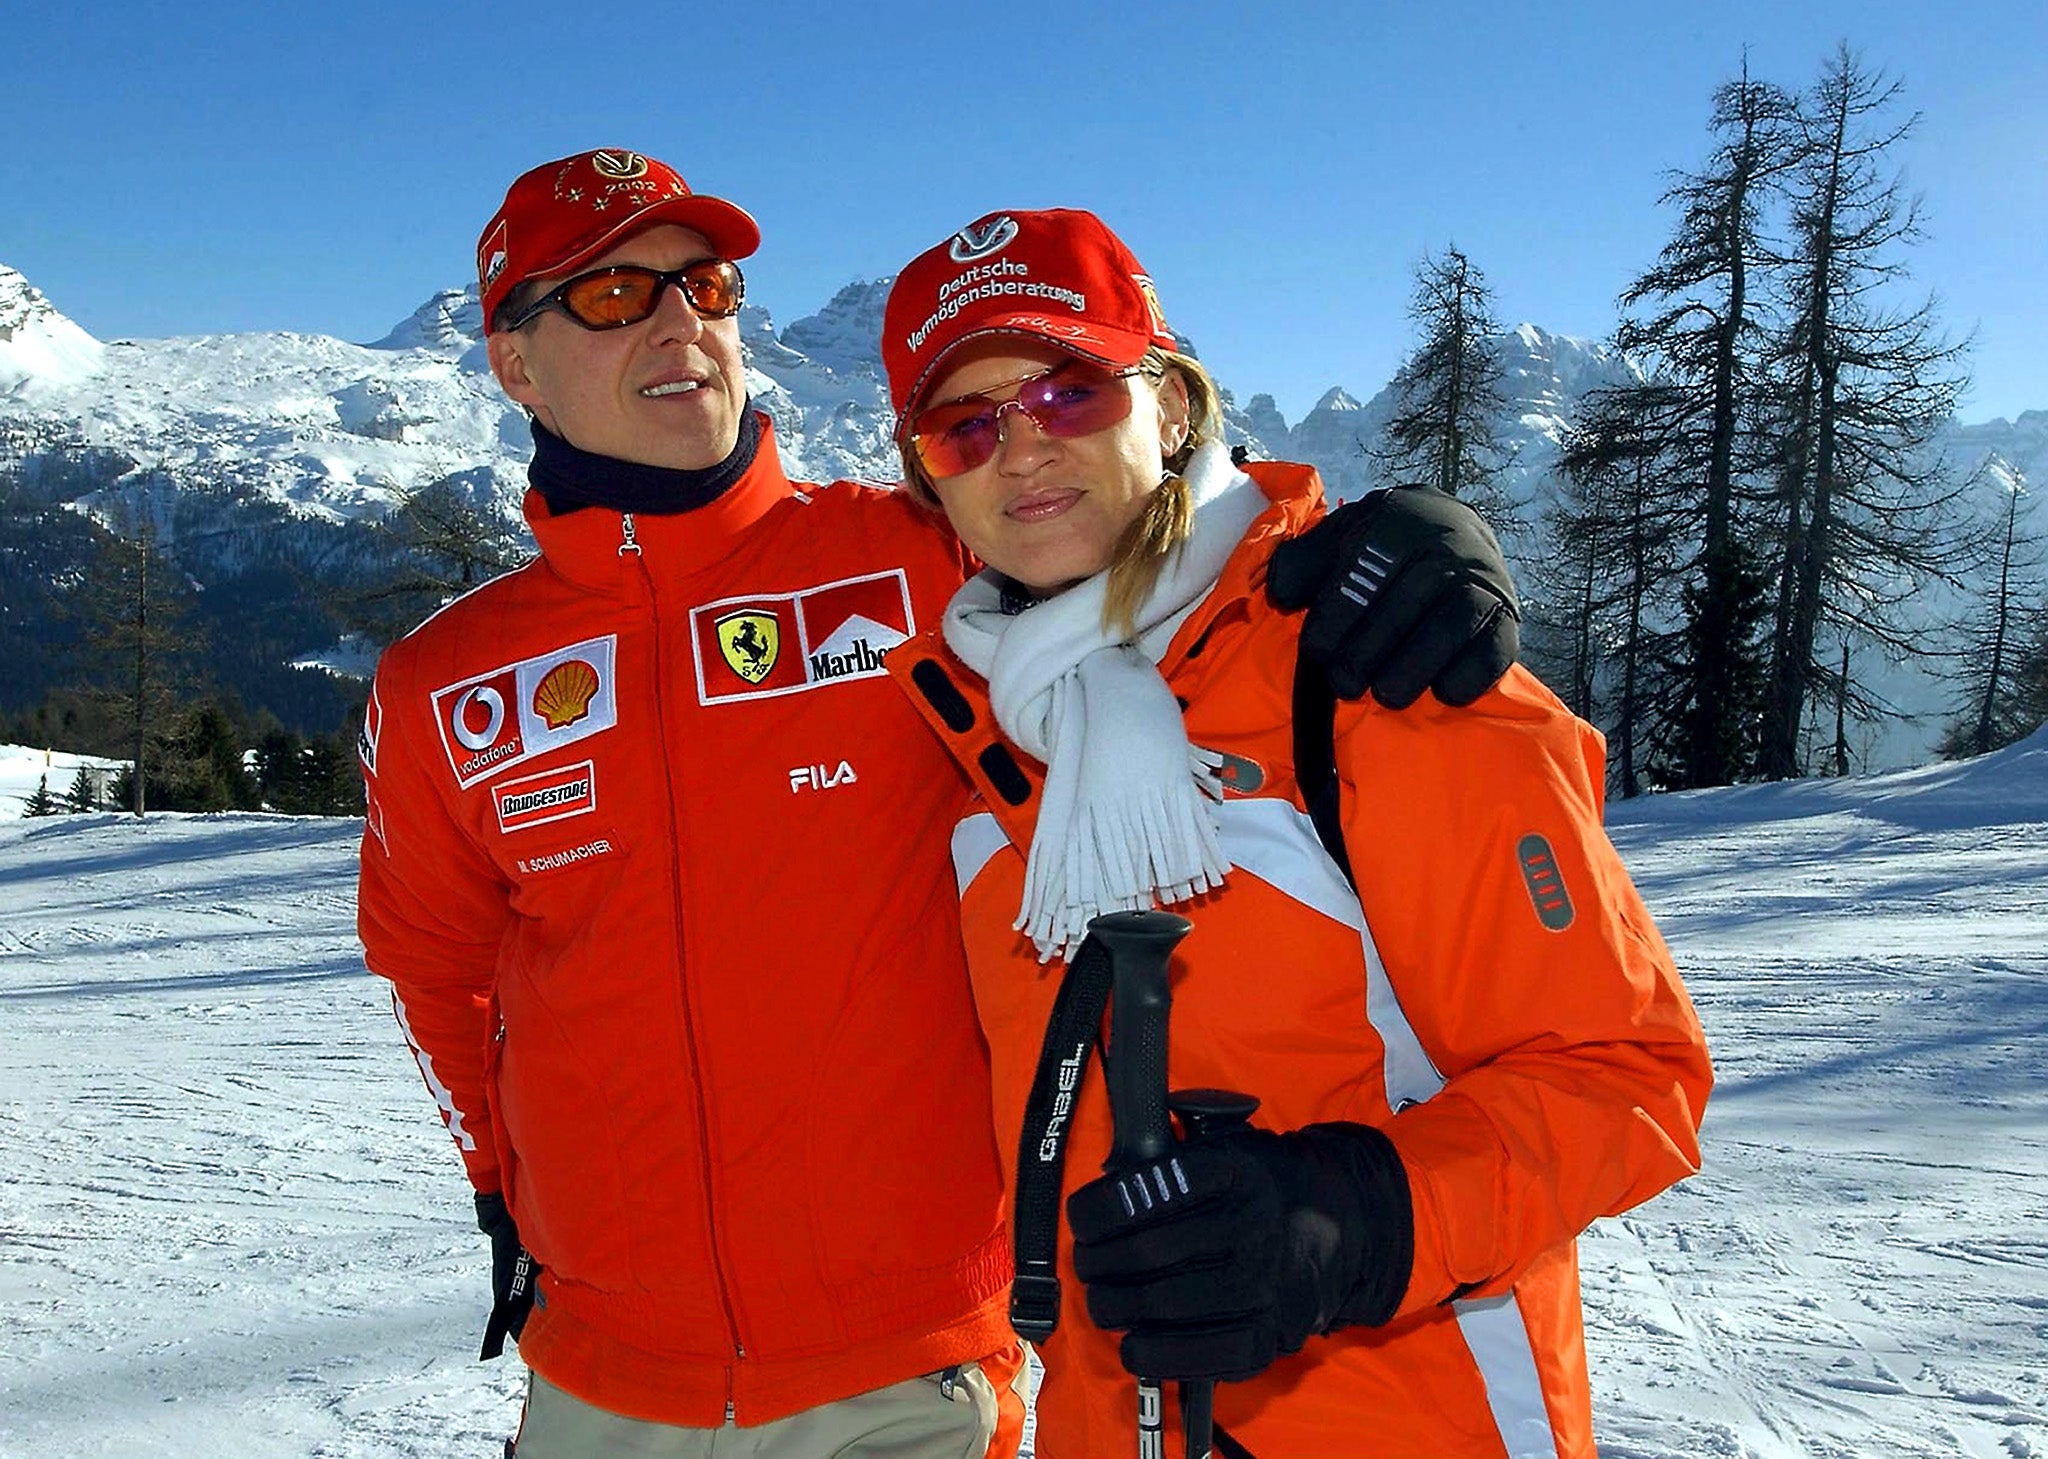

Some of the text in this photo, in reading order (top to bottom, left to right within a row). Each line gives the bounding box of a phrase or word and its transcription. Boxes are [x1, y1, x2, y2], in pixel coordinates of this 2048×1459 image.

[604, 180, 658, 195] 2002
[938, 257, 1029, 301] Deutsche
[906, 279, 1085, 353] Vermögensberatung
[808, 637, 894, 682] Marlbo
[459, 740, 517, 775] vodafone
[788, 760, 858, 794] FILA
[502, 779, 589, 817] BRIDGESTONE
[529, 839, 613, 872] SCHUMACHER
[1038, 1042, 1084, 1162] GABEL
[508, 1244, 531, 1301] ABEL
